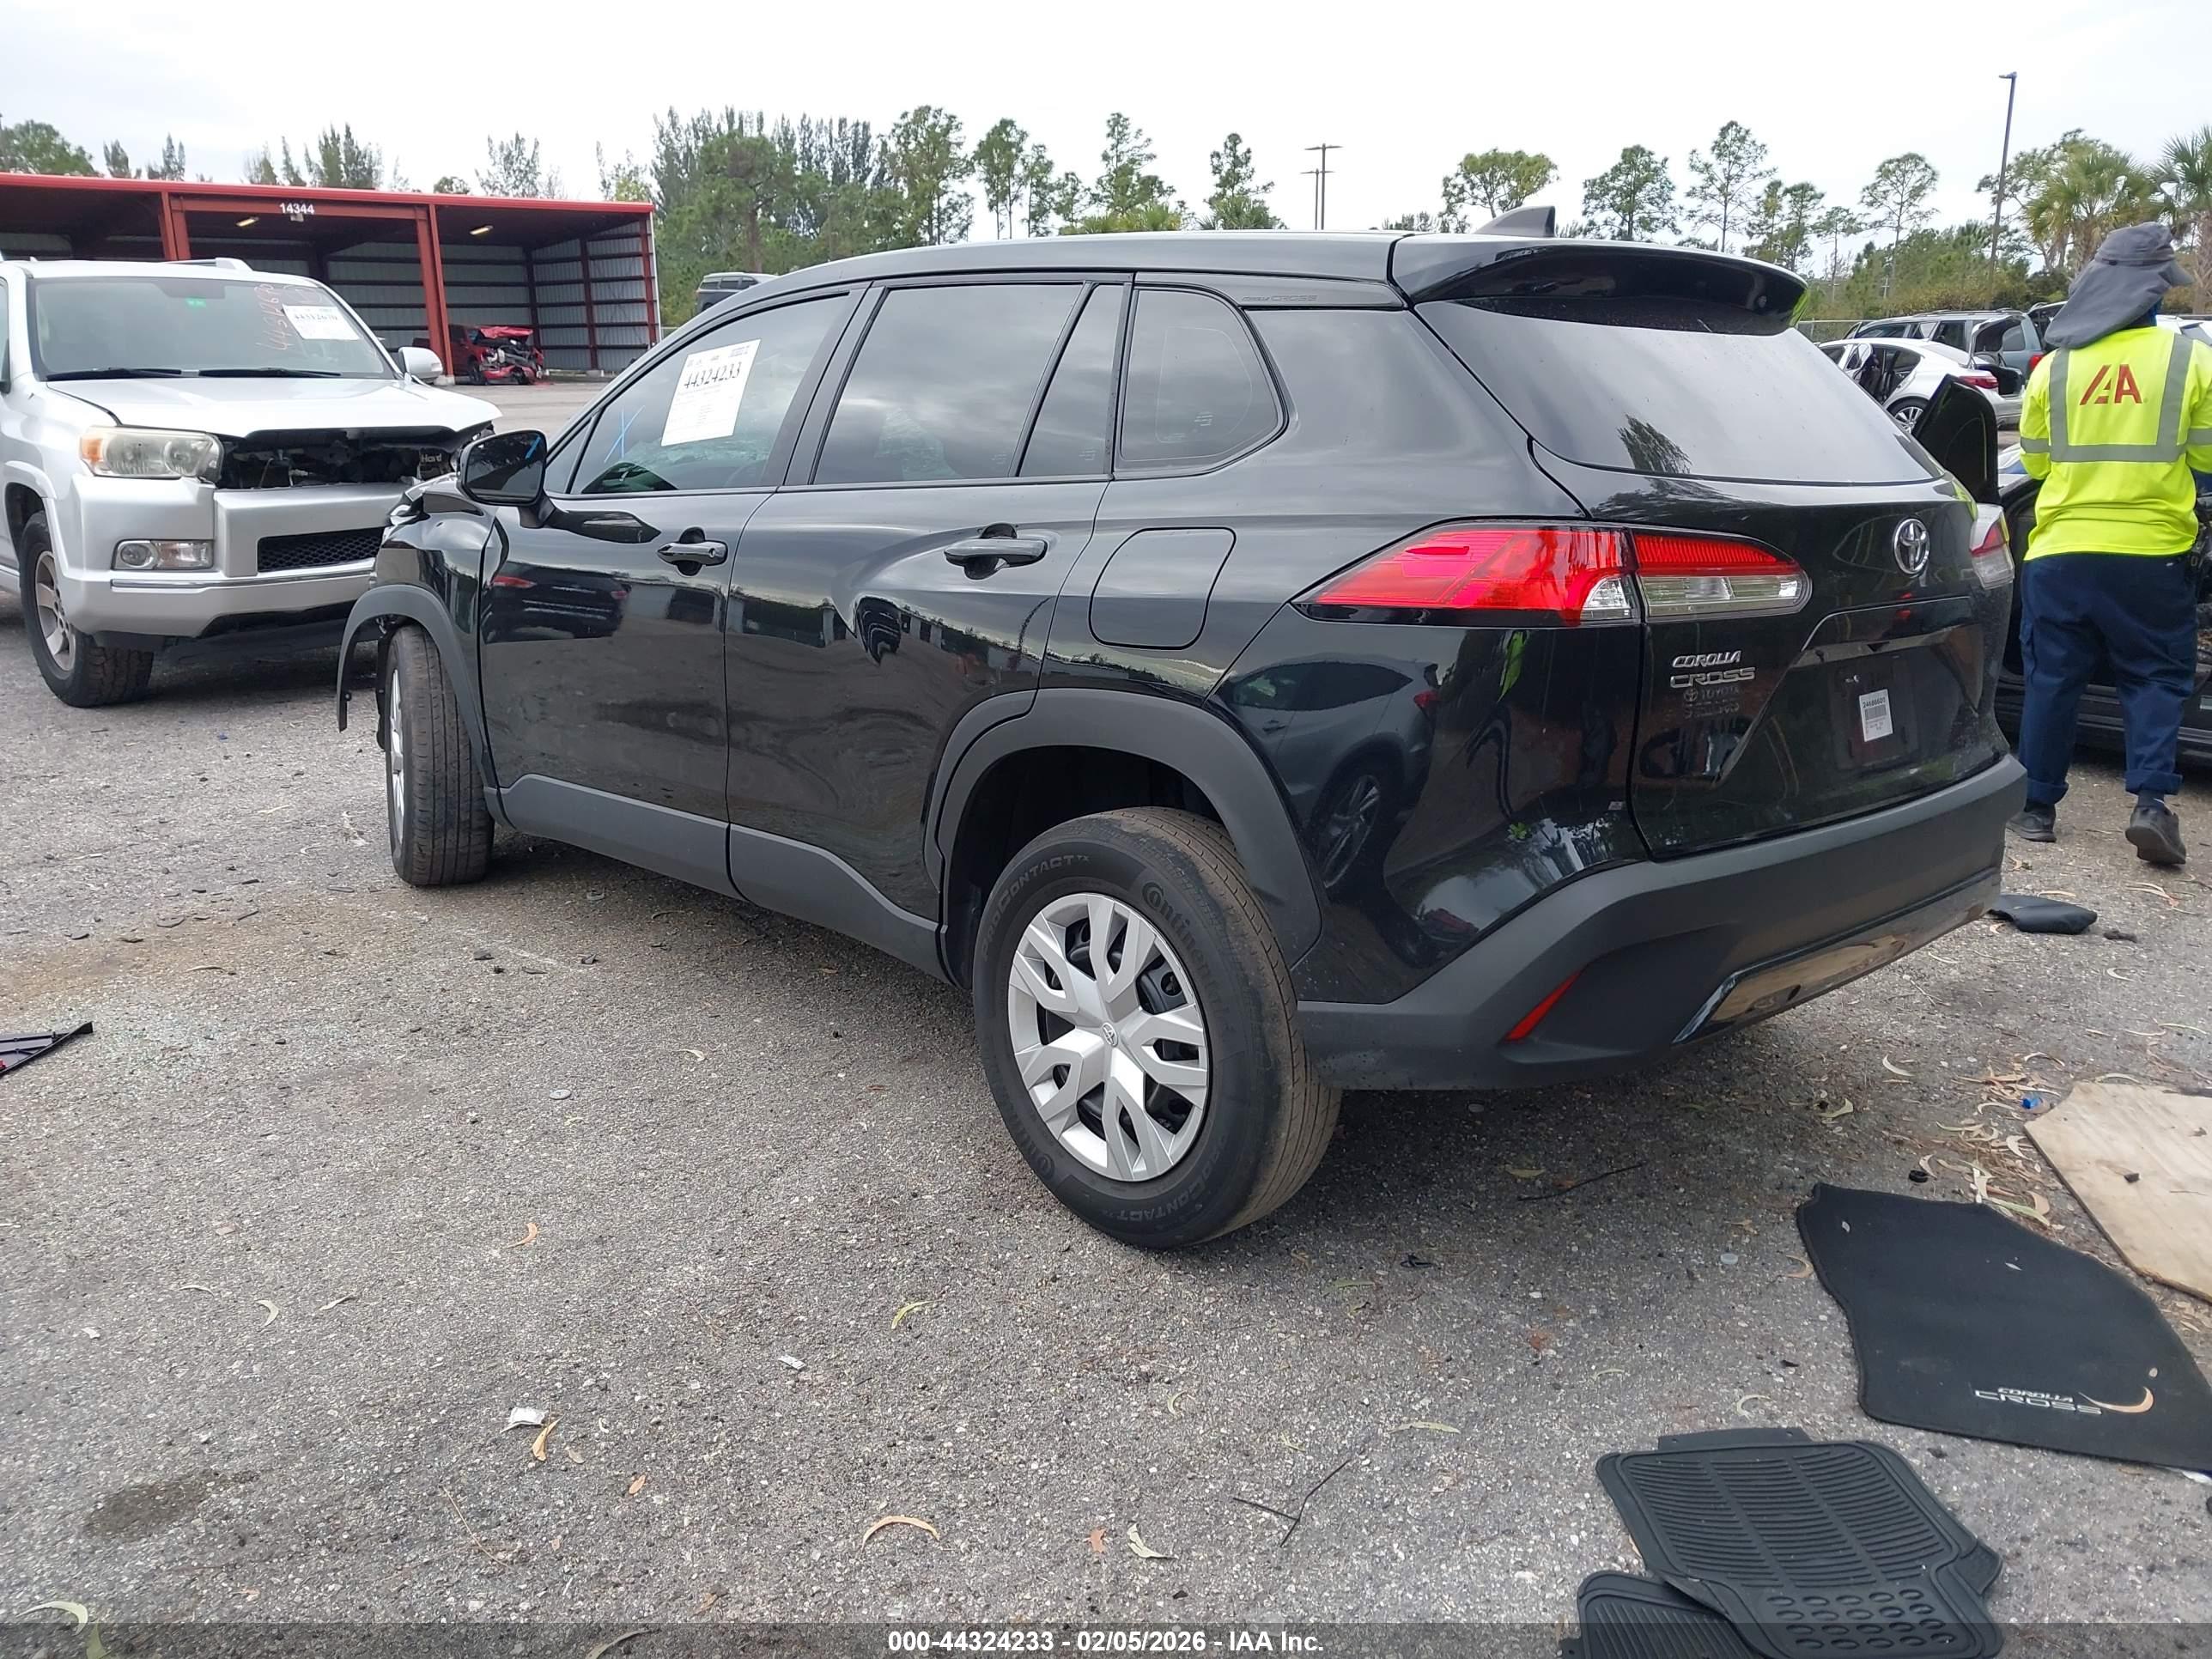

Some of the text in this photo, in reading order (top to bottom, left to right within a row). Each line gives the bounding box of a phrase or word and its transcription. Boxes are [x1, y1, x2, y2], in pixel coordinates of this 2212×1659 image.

[279, 203, 315, 215] 14344
[684, 361, 742, 389] 44324233
[1672, 650, 1741, 668] COROLLA
[1669, 666, 1756, 689] CROSS
[1975, 1389, 2102, 1415] CROSS
[1997, 1387, 2074, 1403] COROLLA
